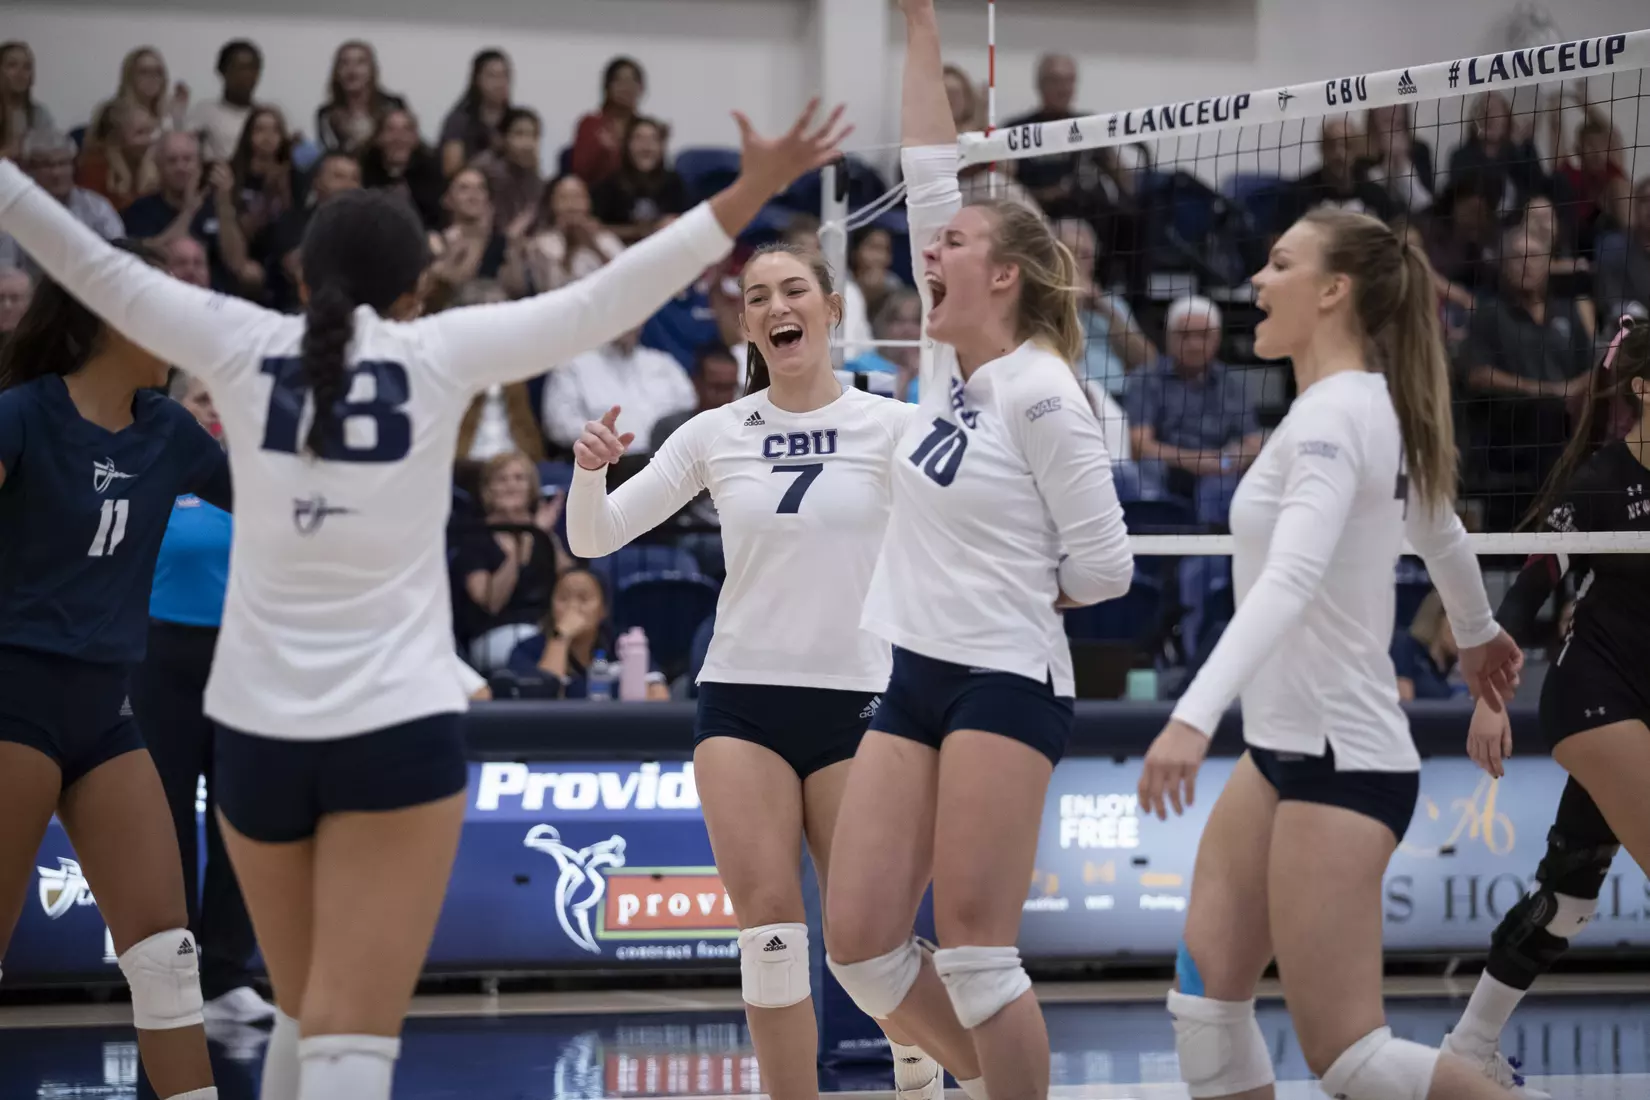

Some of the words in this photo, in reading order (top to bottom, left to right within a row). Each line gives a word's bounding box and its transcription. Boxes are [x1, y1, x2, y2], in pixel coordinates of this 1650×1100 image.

[1008, 125, 1043, 151] CBU
[1108, 93, 1250, 137] #LANCEUP
[1325, 76, 1367, 106] CBU
[1448, 35, 1626, 89] #LANCEUP
[260, 357, 412, 463] 18
[744, 419, 765, 427] adidas
[762, 428, 838, 460] CBU
[908, 416, 968, 487] 10
[771, 463, 824, 514] 7
[87, 499, 129, 557] 11
[475, 761, 702, 811] Provid
[1060, 793, 1139, 818] ENJOY
[1060, 817, 1140, 849] FREE
[763, 944, 787, 952] adidas
